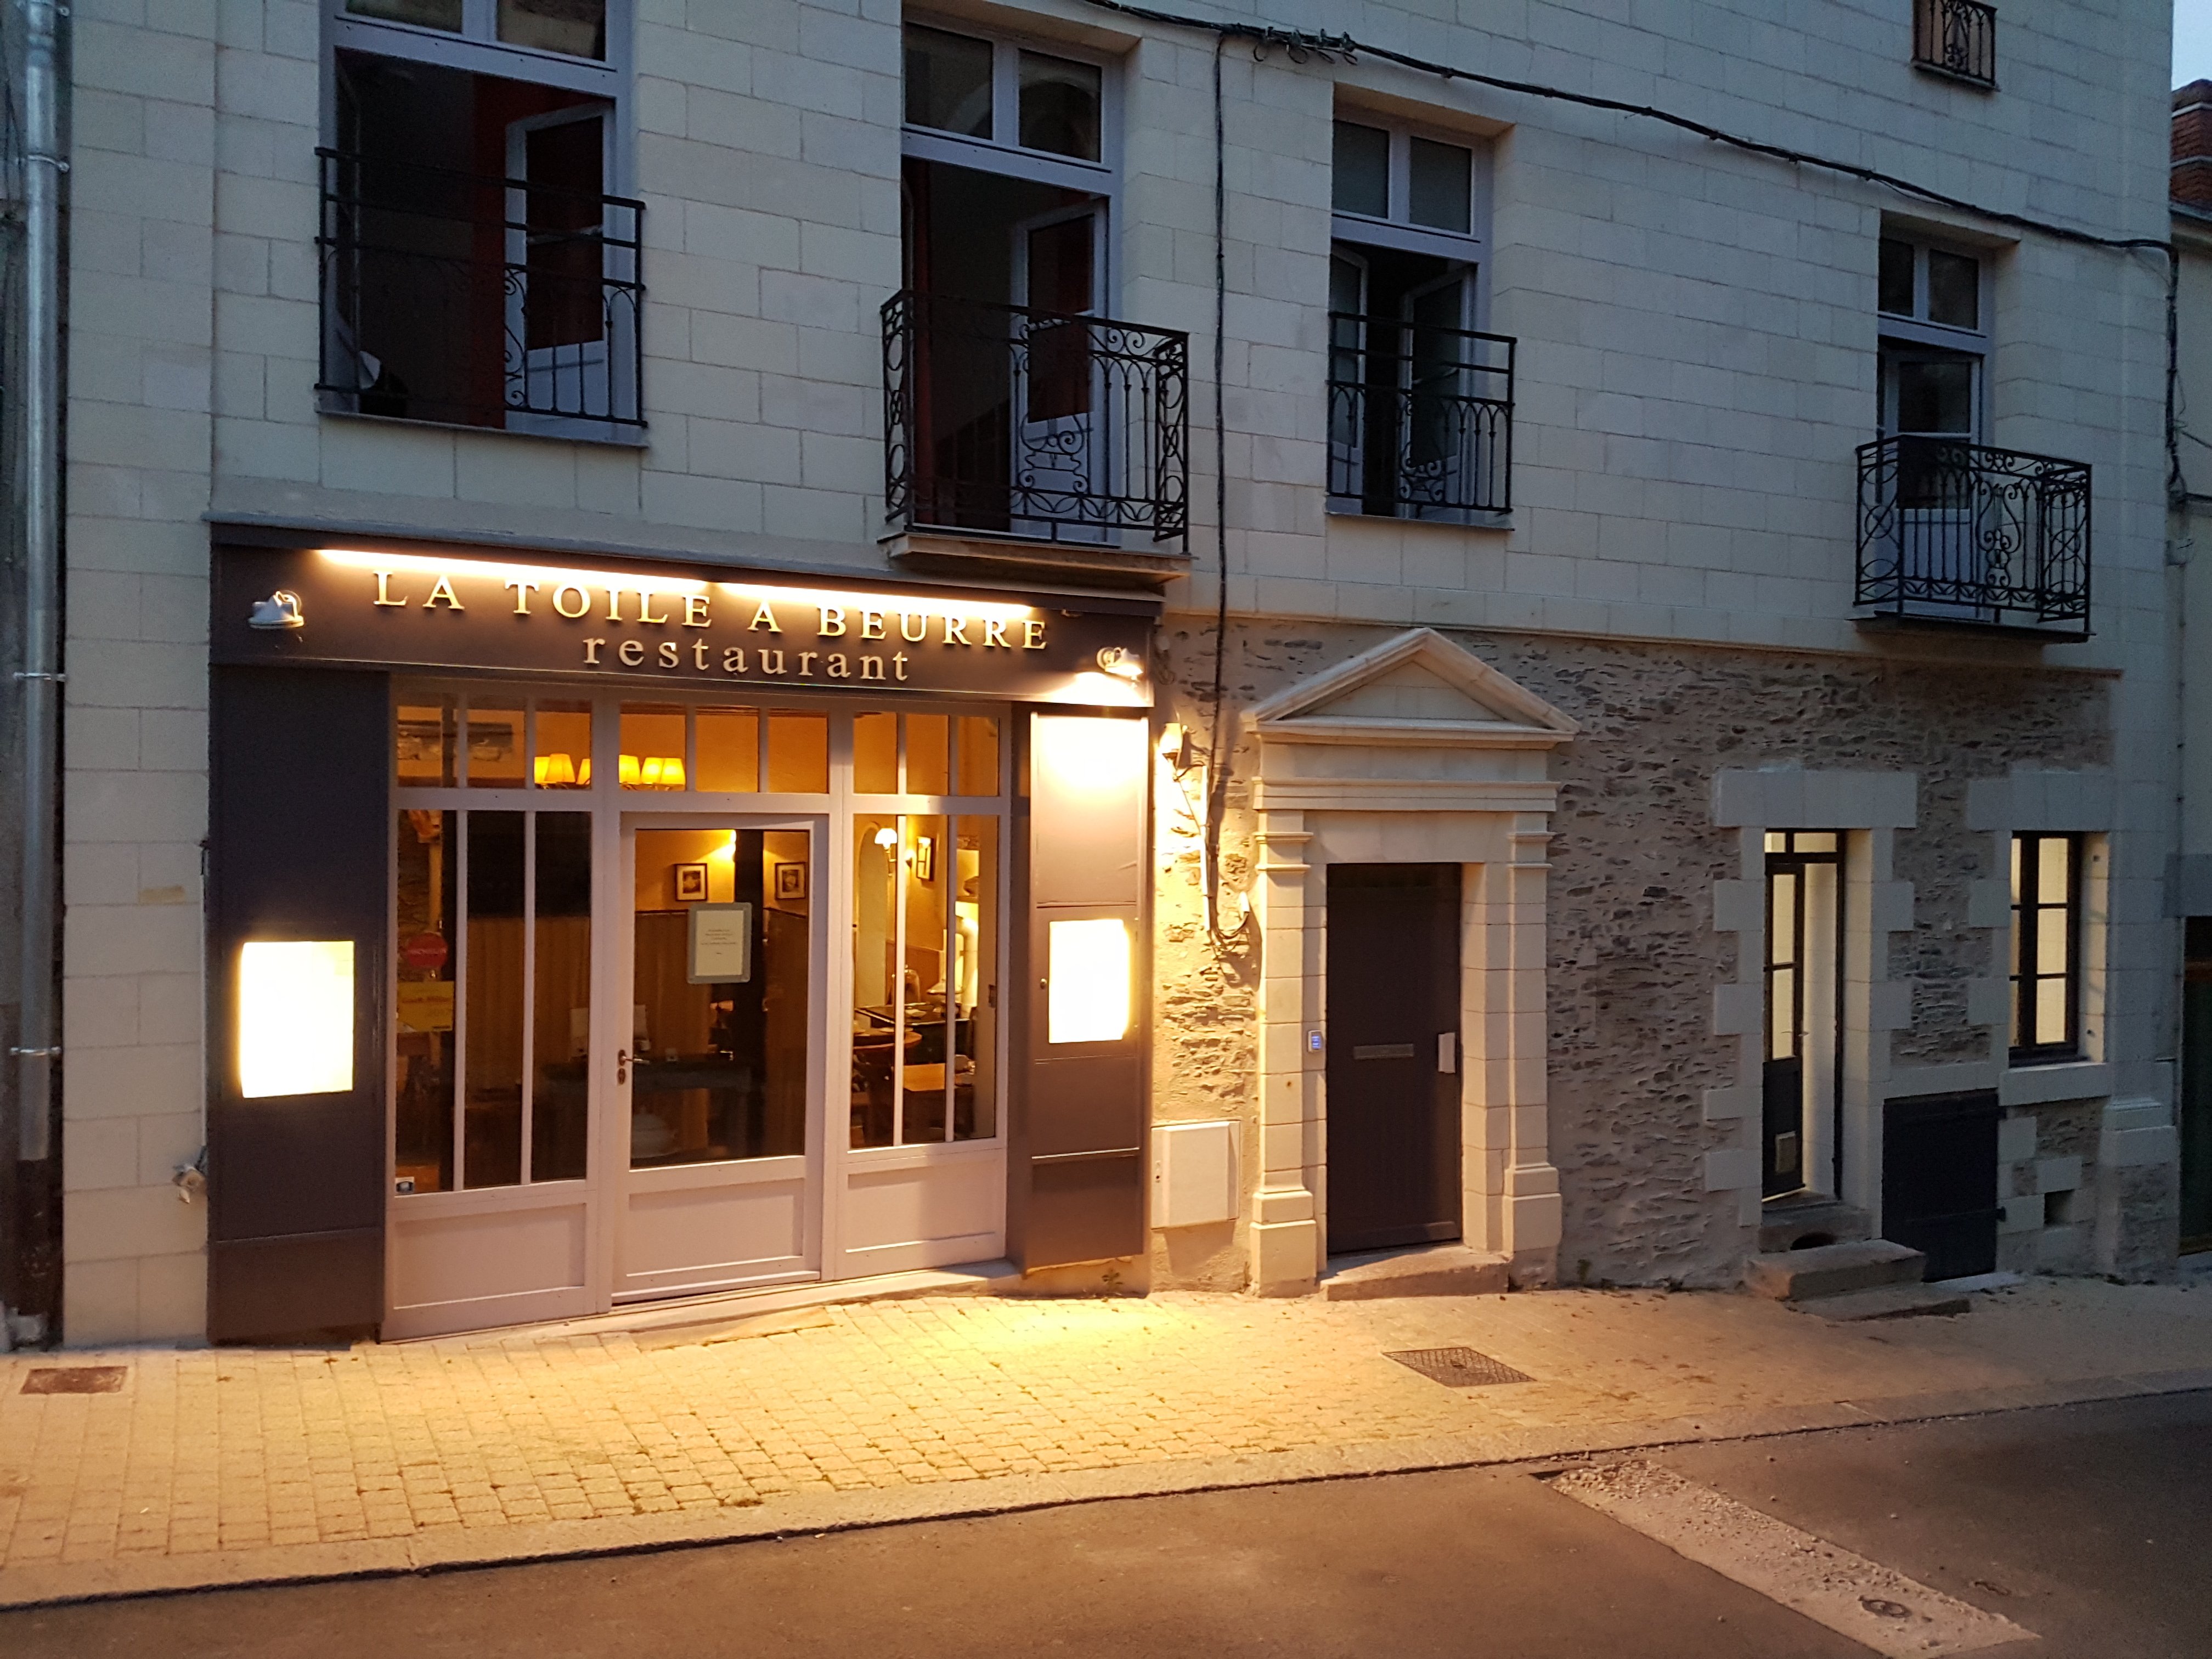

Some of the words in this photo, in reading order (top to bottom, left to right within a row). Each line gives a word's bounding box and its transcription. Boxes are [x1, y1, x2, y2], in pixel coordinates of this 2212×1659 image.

[373, 571, 465, 611] LA
[504, 580, 713, 628] TOILE
[747, 602, 783, 633] A
[816, 603, 1048, 650] BEURRE
[583, 637, 909, 682] restaurant
